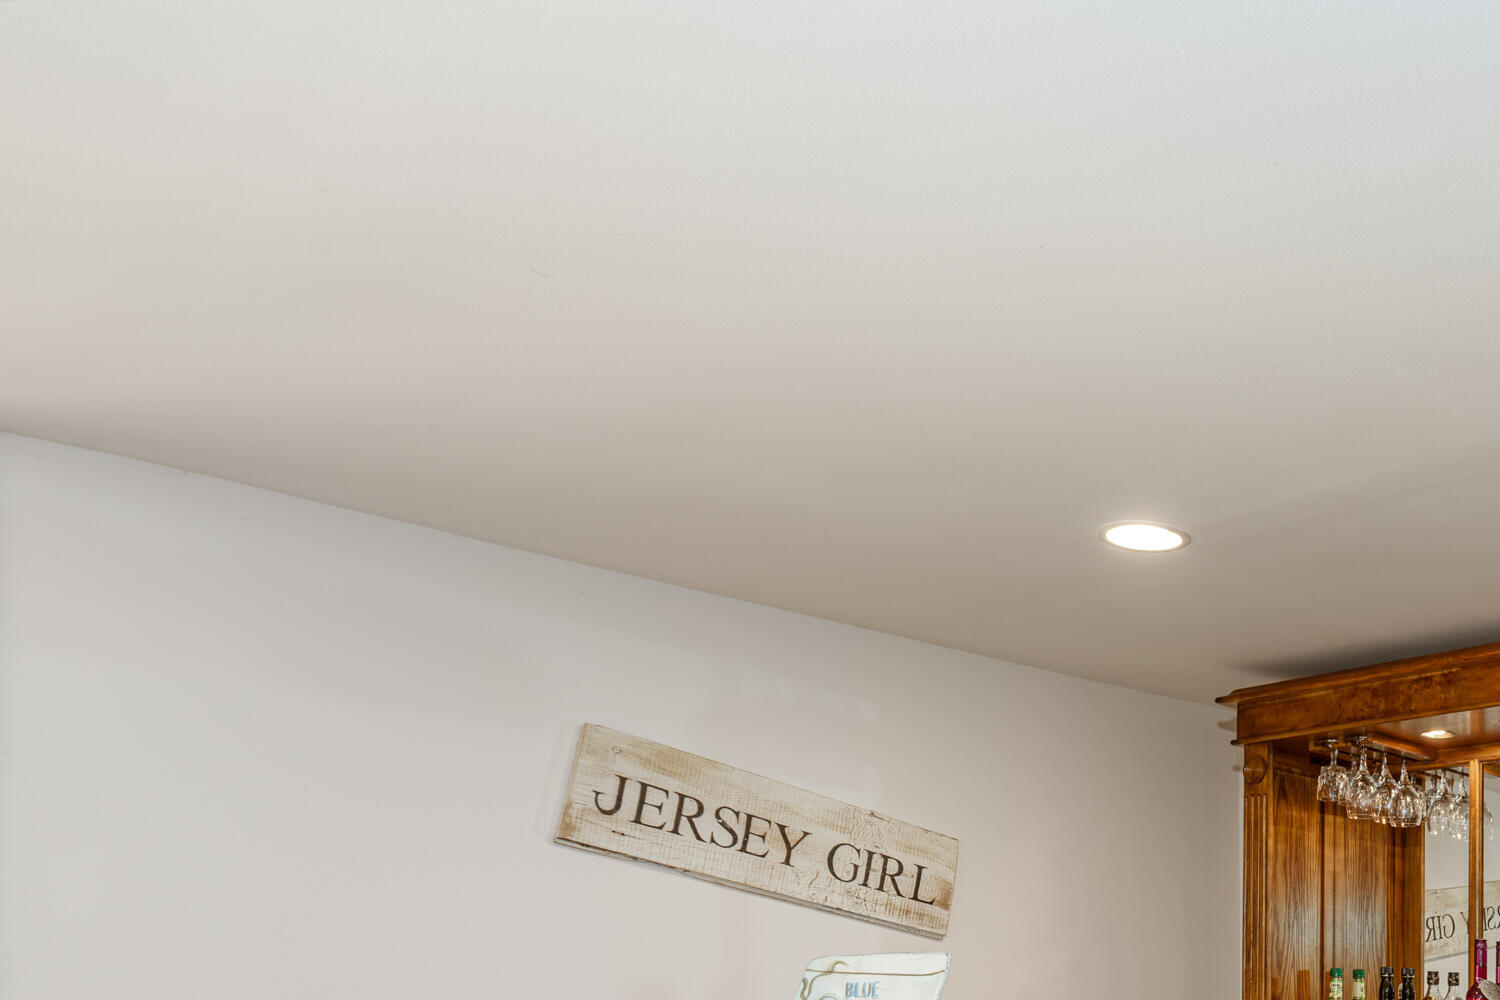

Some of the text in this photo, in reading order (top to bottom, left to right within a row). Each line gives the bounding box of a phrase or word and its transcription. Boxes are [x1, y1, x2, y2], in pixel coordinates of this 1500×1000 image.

[592, 773, 936, 906] JERSEY GIRL
[845, 980, 880, 999] BLUE
